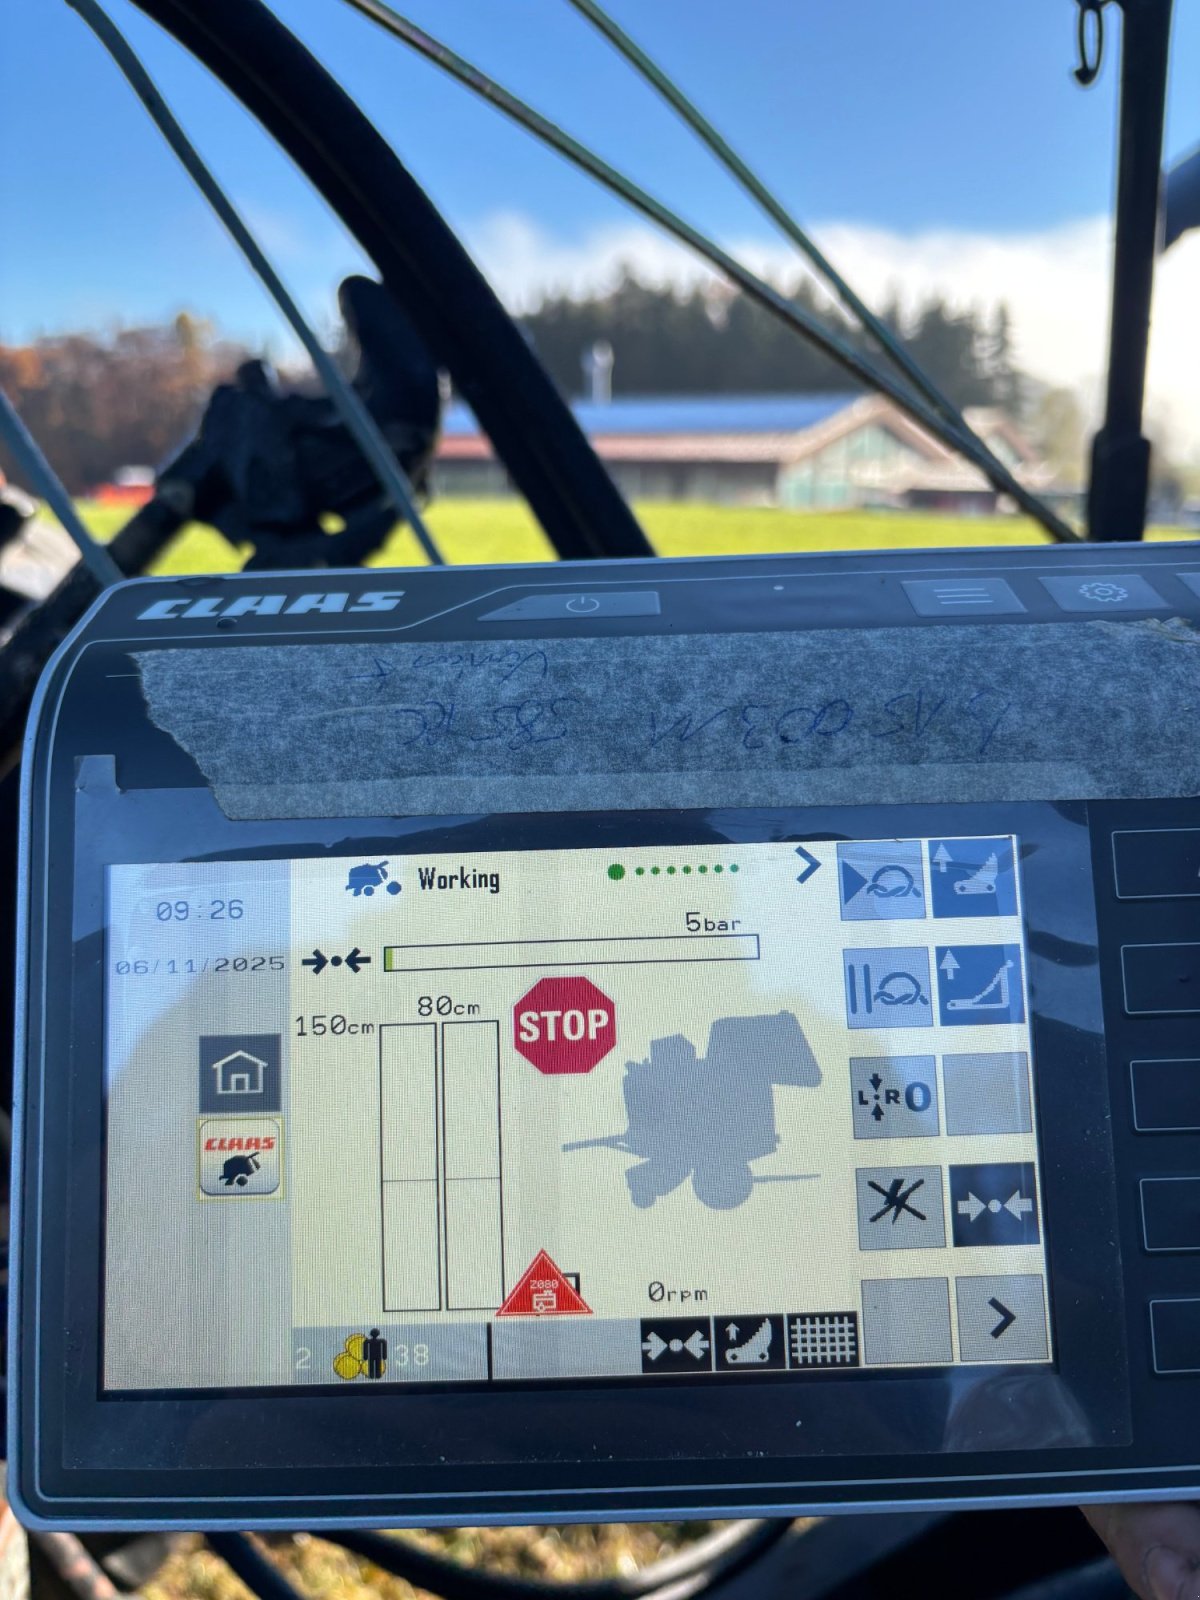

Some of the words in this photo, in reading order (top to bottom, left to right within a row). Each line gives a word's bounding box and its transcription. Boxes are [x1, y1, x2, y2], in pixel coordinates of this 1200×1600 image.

[136, 590, 406, 620] CLAAS
[418, 866, 501, 894] Working
[155, 899, 245, 922] 09:26
[685, 911, 742, 932] 5bar
[115, 956, 286, 976] 06/11/2025
[418, 995, 481, 1017] 80cm
[295, 1014, 376, 1037] 150cm
[518, 1009, 610, 1044] STOP
[203, 1136, 276, 1151] CLAAS
[648, 1281, 709, 1303] 0rpm
[295, 1349, 312, 1370] 2
[394, 1342, 431, 1366] 38
